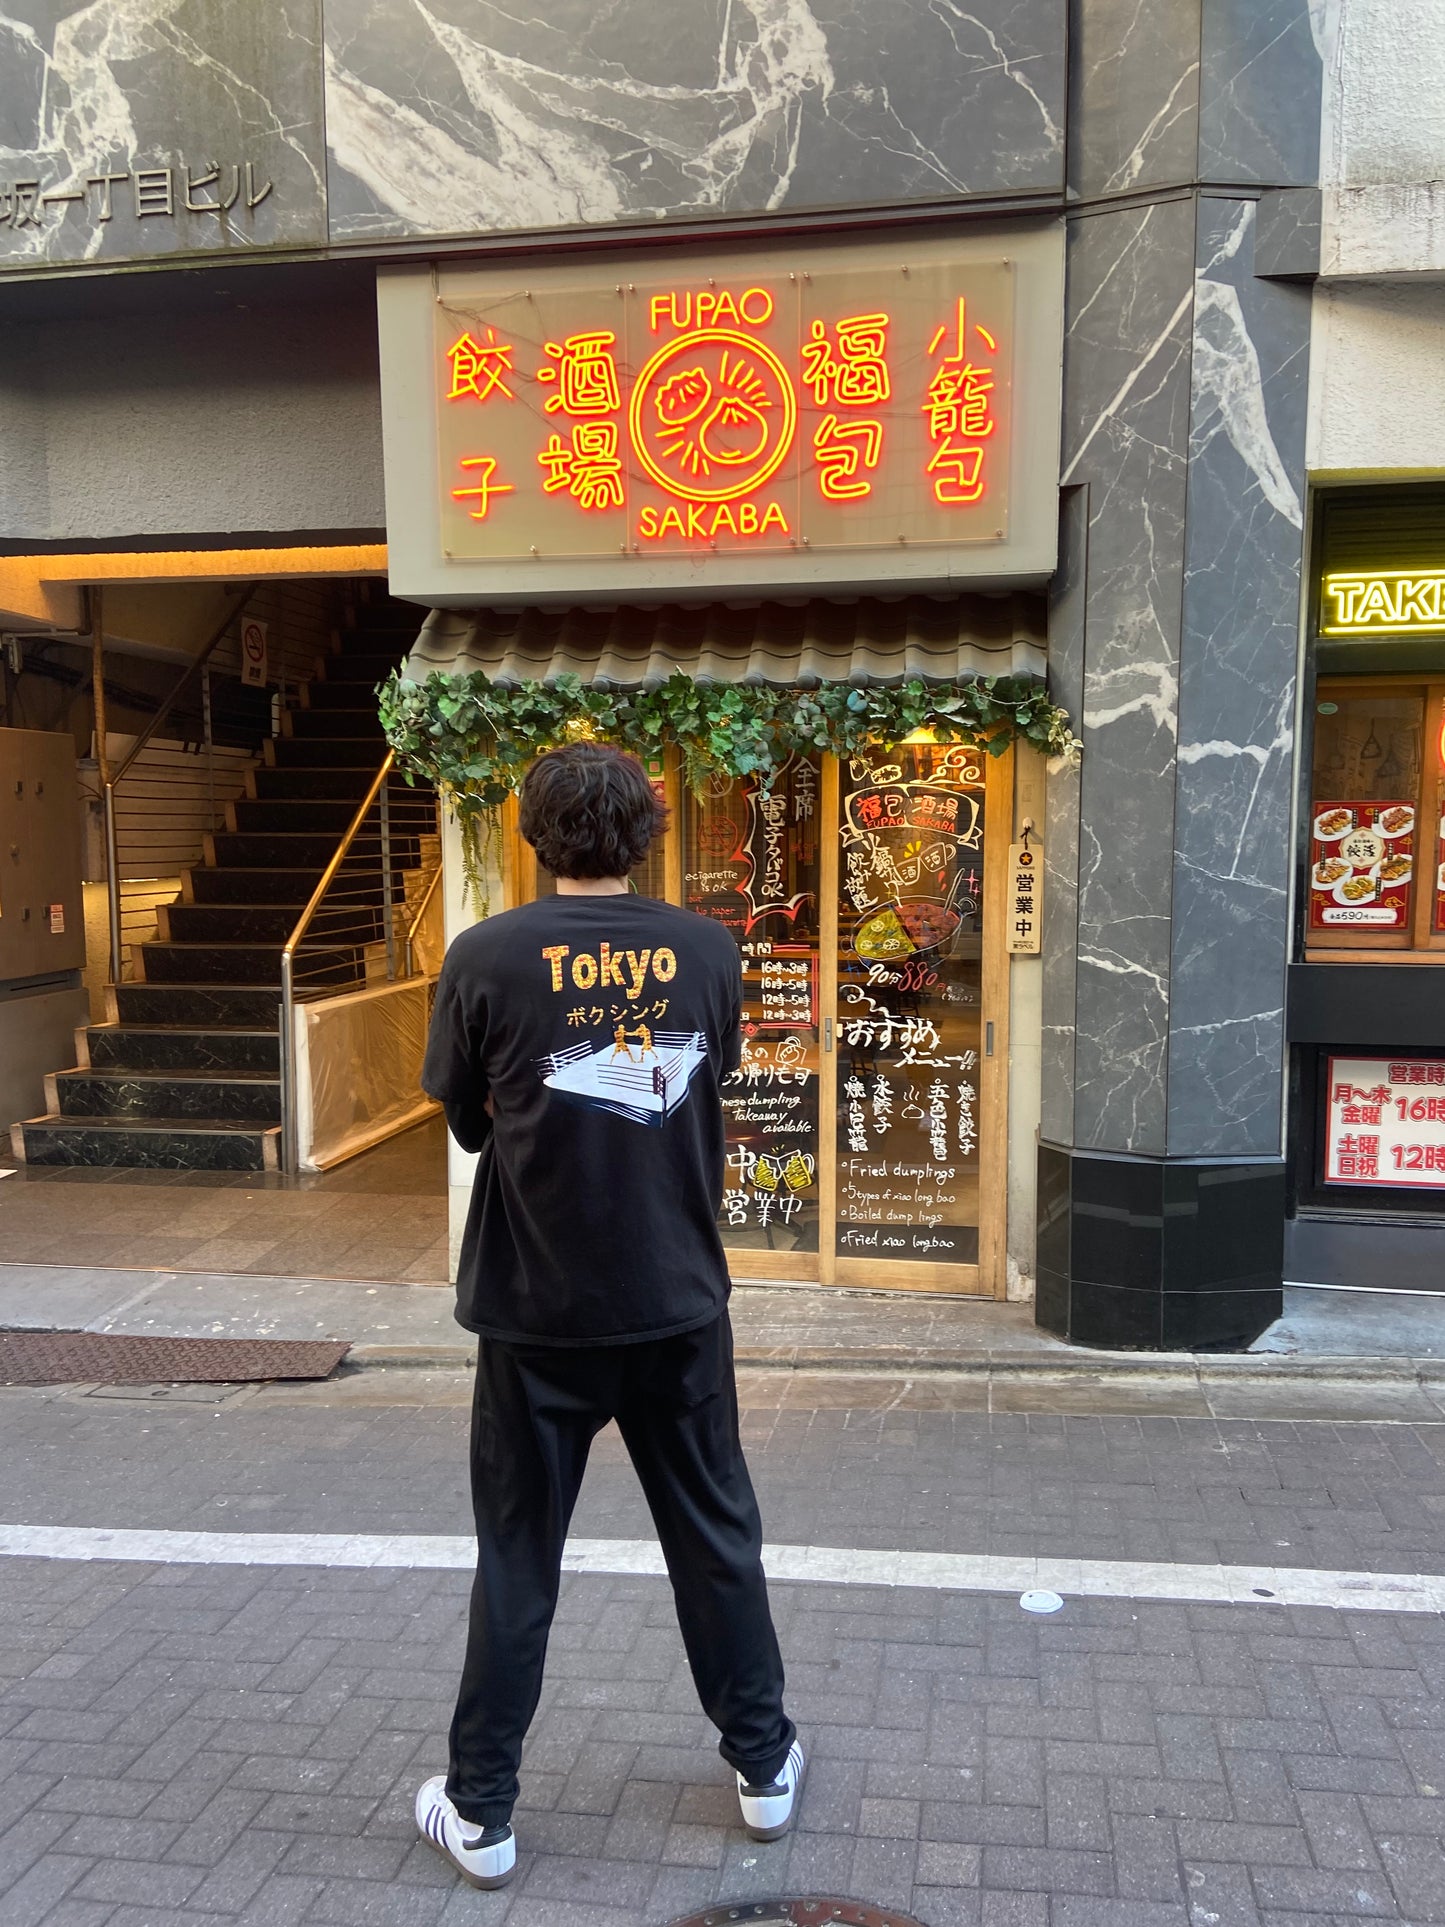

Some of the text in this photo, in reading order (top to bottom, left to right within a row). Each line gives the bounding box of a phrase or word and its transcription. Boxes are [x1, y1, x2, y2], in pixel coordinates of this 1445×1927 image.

[650, 288, 773, 331] FUPAO
[801, 313, 890, 501] 福包
[922, 296, 997, 504] 小籠包
[446, 330, 515, 520] 餃子
[537, 331, 626, 510] 酒場
[640, 503, 789, 539] SAKABA
[791, 757, 820, 822] 全席
[866, 816, 955, 833] FUPAO SAKABA
[912, 795, 959, 821] 酒場
[1015, 874, 1034, 937] 営業中
[542, 942, 677, 999] Tokyo
[566, 999, 670, 1028] ボクシング
[844, 1018, 941, 1051] おすすめ
[747, 1092, 802, 1110] dumpling
[1341, 1104, 1382, 1126] 金曜
[1337, 1133, 1380, 1156] 土曜
[850, 1158, 956, 1186] Fried dumplings
[1337, 1155, 1378, 1178] 日祝
[722, 1189, 803, 1228] 営業中
[849, 1204, 882, 1221] Boiled
[847, 1230, 879, 1248] Fried
